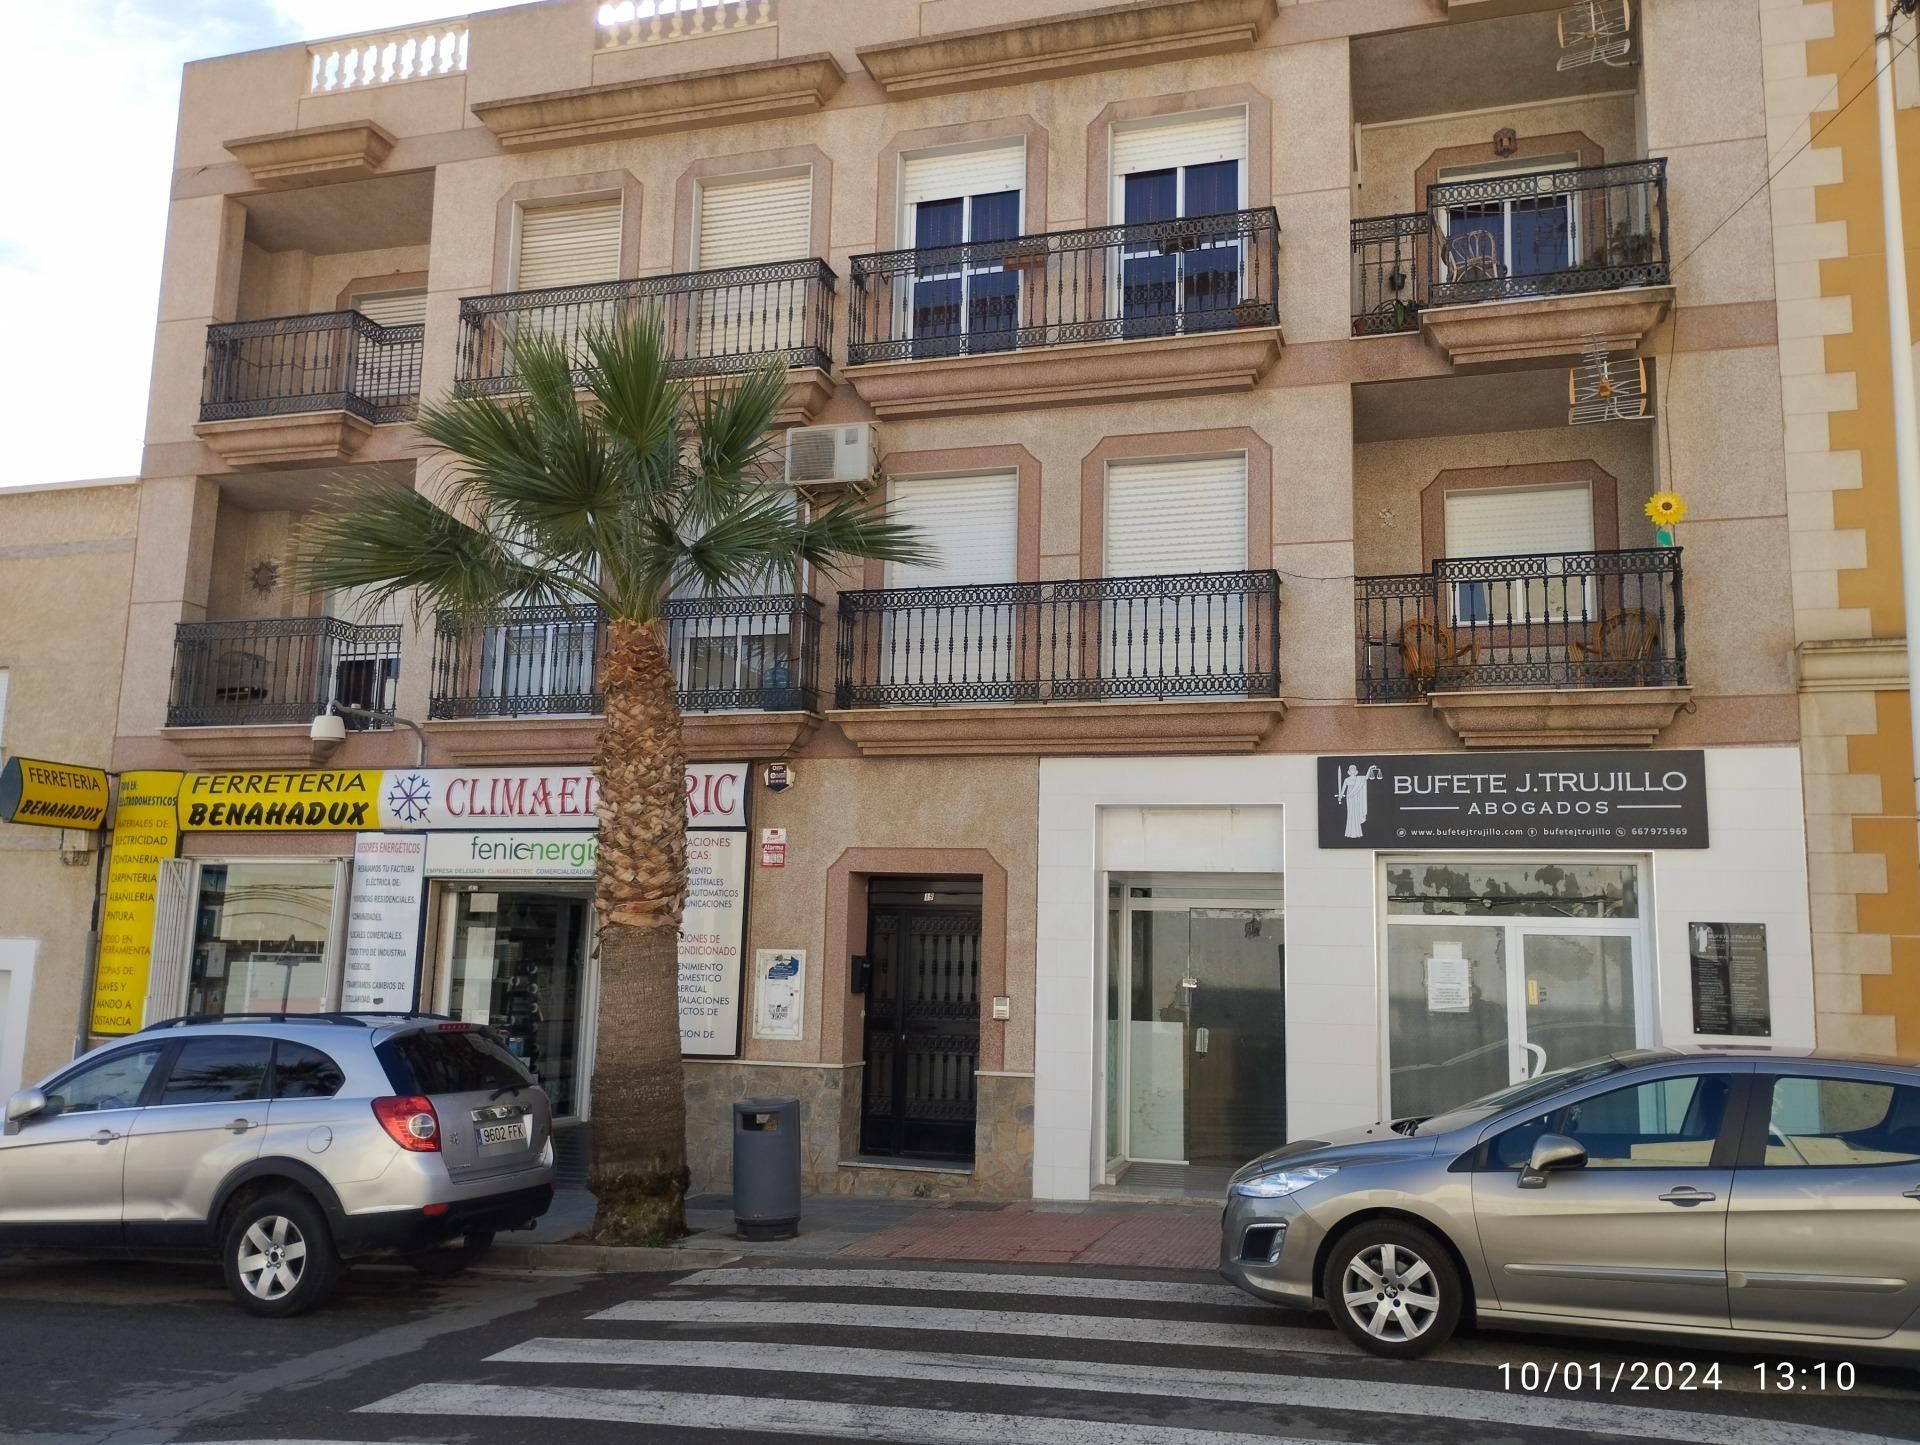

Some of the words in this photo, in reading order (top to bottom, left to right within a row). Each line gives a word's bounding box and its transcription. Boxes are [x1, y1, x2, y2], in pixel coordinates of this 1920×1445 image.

[28, 767, 101, 791] FERRETERIA
[192, 773, 366, 794] FERRETERIA
[1394, 774, 1507, 795] BUFETE
[1516, 771, 1687, 793] J.TRUJILLO
[20, 800, 103, 822] BENAHADUX
[1467, 801, 1610, 815] ABOGADOS
[188, 801, 370, 826] BENAHADUX
[117, 819, 153, 829] MATERIALES
[156, 819, 169, 829] DE
[1411, 828, 1524, 838] www.bufetejtrujillo.com
[1543, 827, 1611, 837] bufetejtrujillo
[115, 835, 168, 846] ELECTRICIDAD
[687, 837, 731, 847] ACIONES
[380, 840, 421, 854] ENERGÉTICOS
[382, 865, 390, 873] TU
[391, 865, 415, 873] FACTURA
[111, 873, 157, 884] CARPINTERIA
[691, 889, 739, 898] AUTOMATICOS
[121, 935, 133, 944] EN
[710, 934, 721, 944] DE
[377, 948, 407, 957] INDUSTRIA
[679, 945, 737, 956] ONDICIONADO
[678, 973, 722, 983] OMESTICO
[121, 981, 128, 992] Y
[372, 981, 397, 990] CAMBIOS
[125, 1000, 132, 1009] A
[707, 1007, 719, 1016] DE
[94, 1016, 132, 1026] DISTANCIA
[703, 1030, 715, 1039] DE
[483, 1126, 507, 1143] 9602
